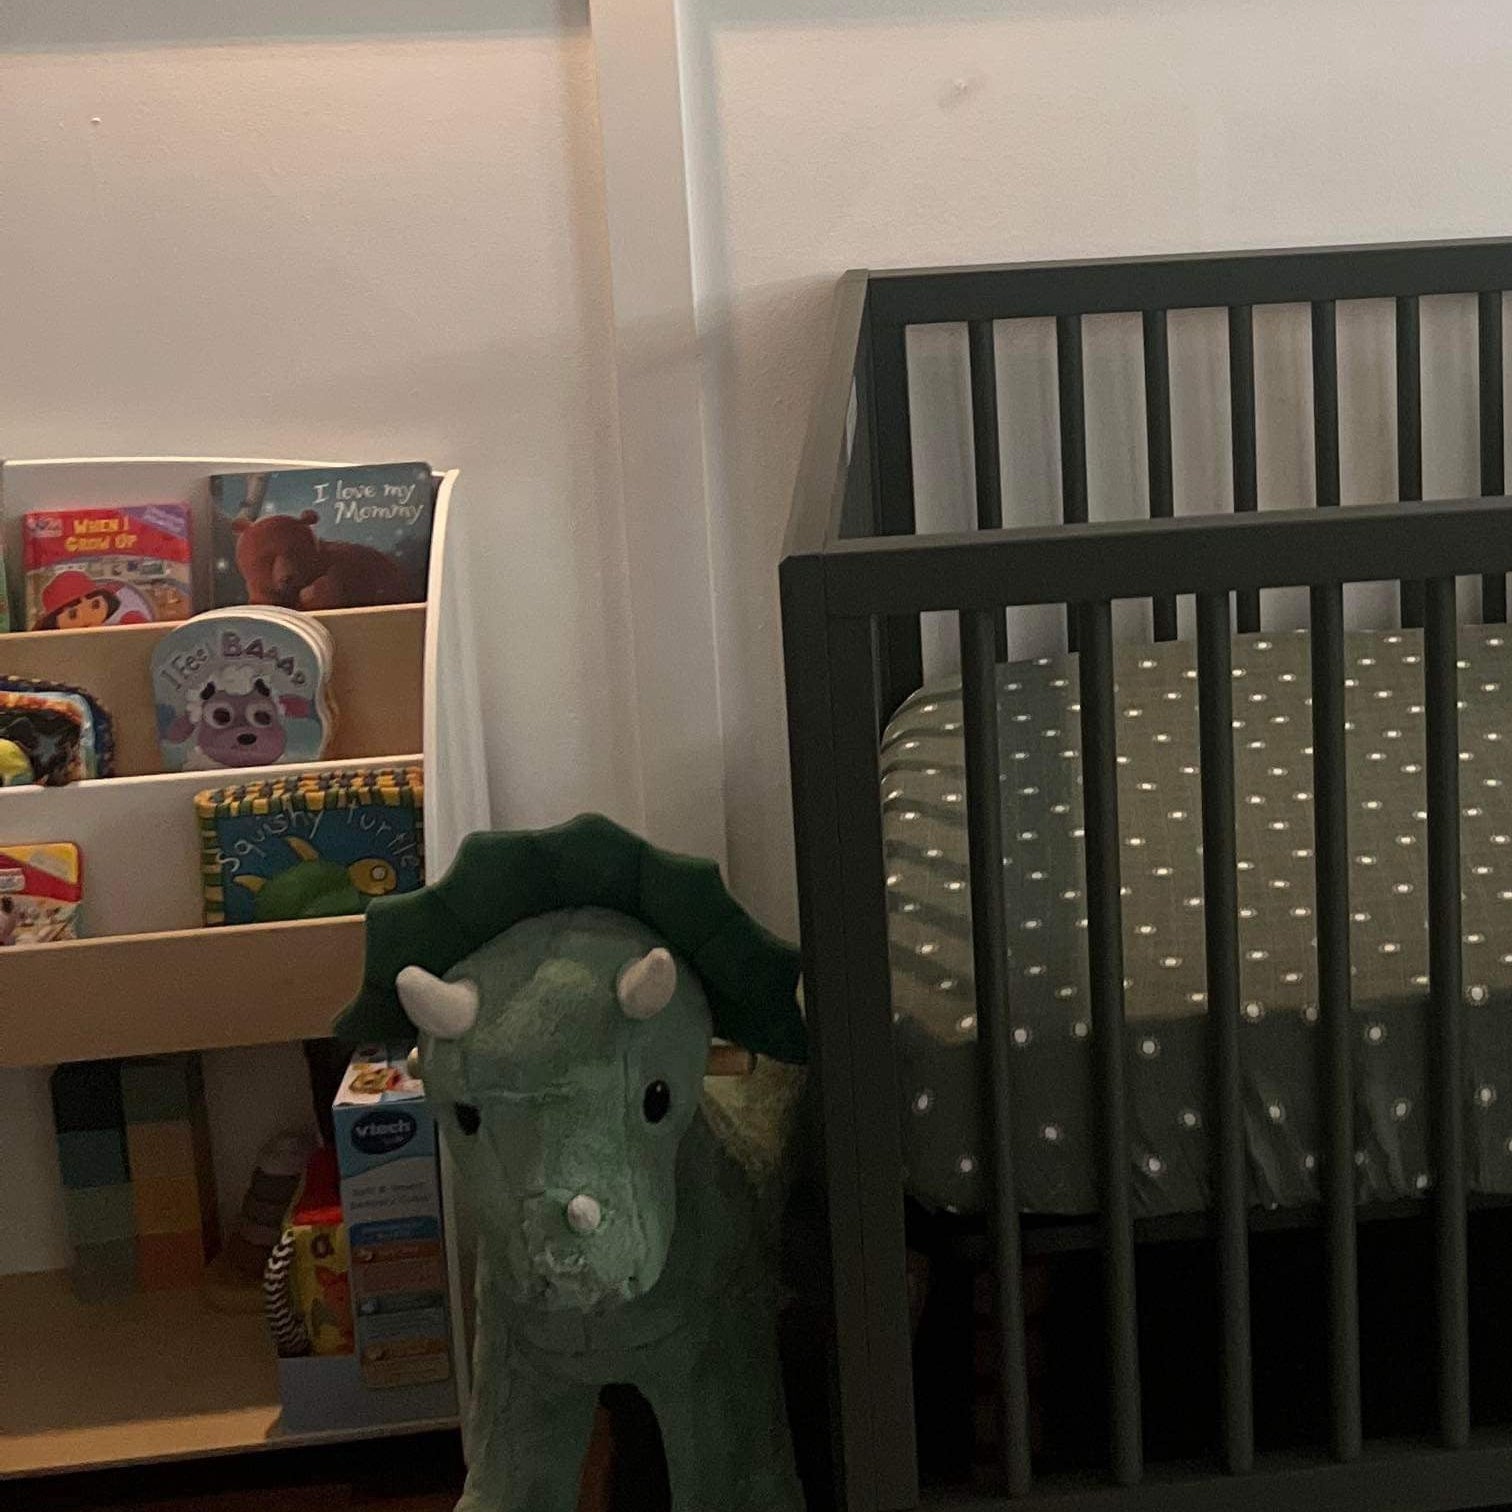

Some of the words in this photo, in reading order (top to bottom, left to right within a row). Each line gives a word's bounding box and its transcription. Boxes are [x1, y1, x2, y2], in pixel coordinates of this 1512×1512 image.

[313, 482, 330, 504] I
[335, 479, 377, 500] love
[383, 483, 416, 504] my
[334, 501, 424, 525] Mommy
[355, 1118, 412, 1138] vtech
